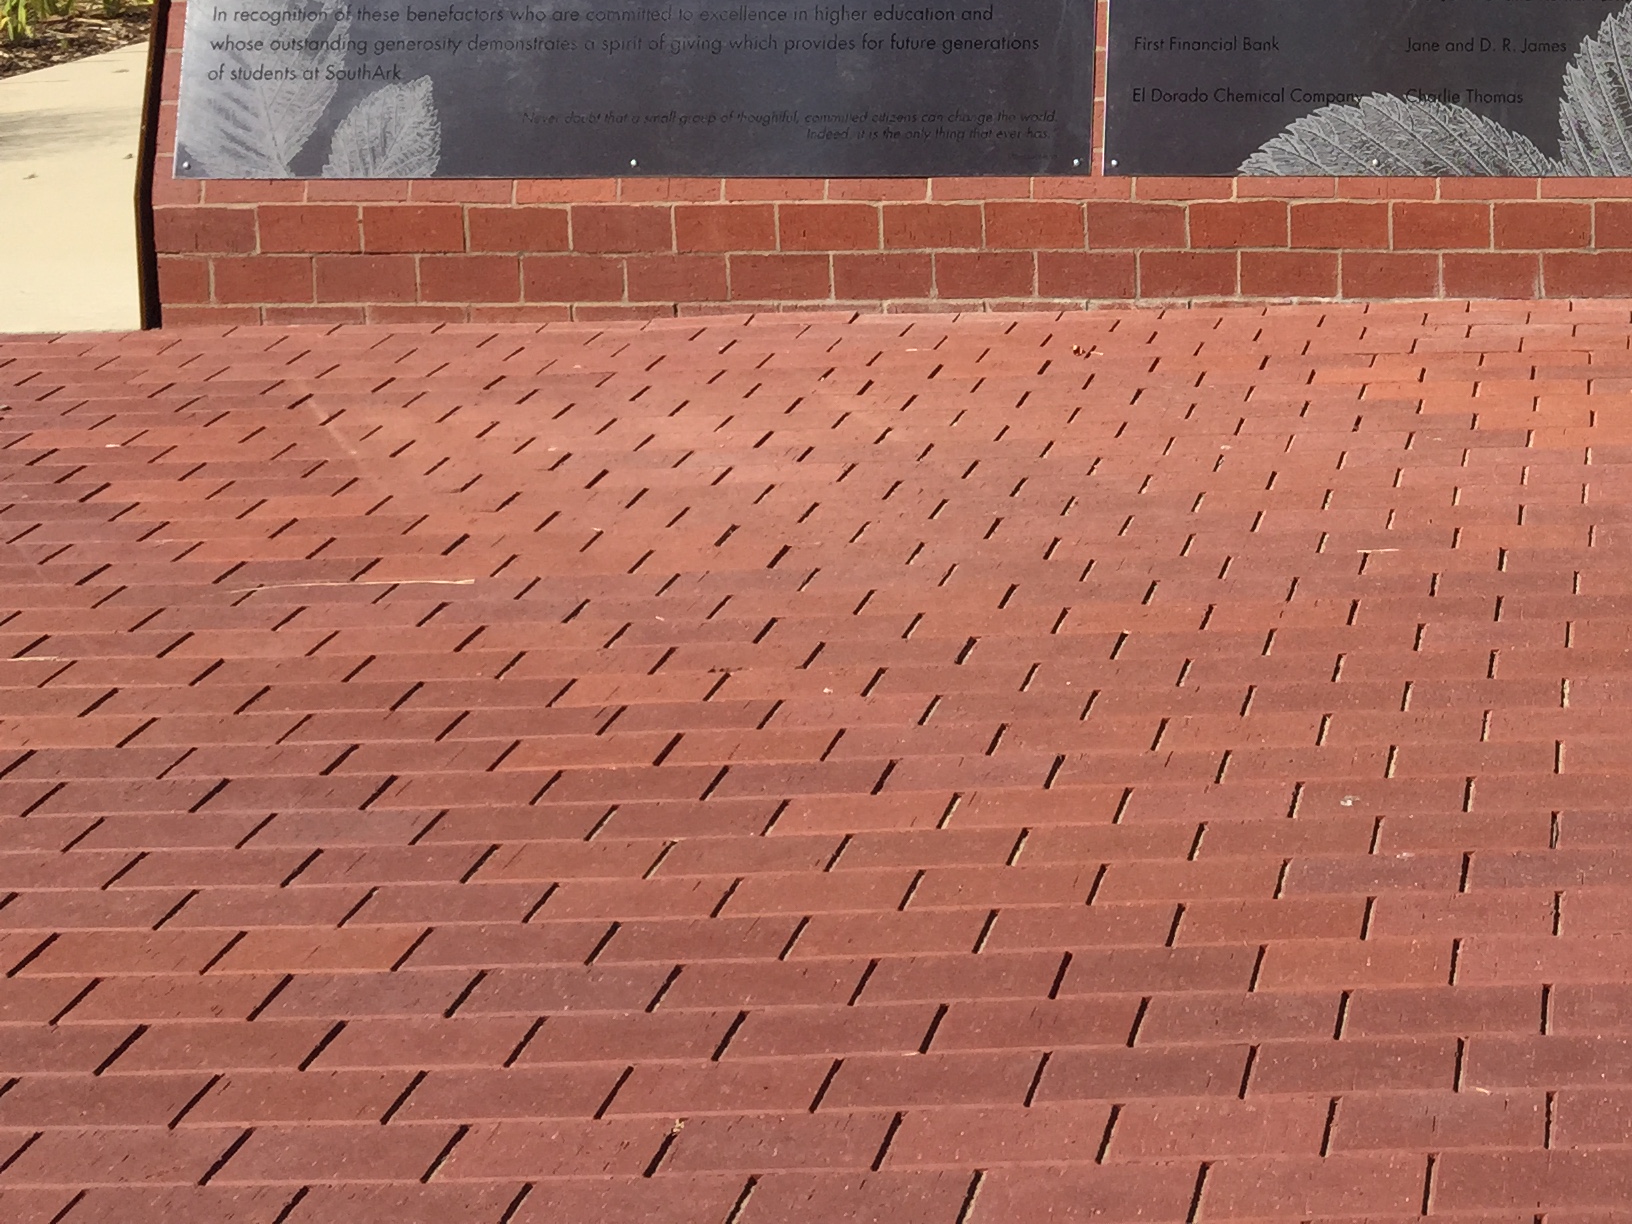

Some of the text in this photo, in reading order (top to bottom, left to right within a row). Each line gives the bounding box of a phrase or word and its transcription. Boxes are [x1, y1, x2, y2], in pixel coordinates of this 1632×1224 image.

[212, 6, 993, 26] In recognition of these benefactors who are committed to excellence in higher education and
[210, 33, 1040, 55] whose outstanding generosity demonstrates a spirit of giving which provides for future generations
[1134, 37, 1279, 51] First Financial Bank
[1405, 38, 1567, 53] Jane and D. R. James
[207, 64, 401, 80] of students at SouthArk
[1133, 88, 1363, 107] El Dorado Chemical Company
[1406, 88, 1524, 104] Charlie Thomas
[564, 111, 601, 123] doubt
[604, 111, 627, 123] that
[631, 115, 640, 123] a
[643, 111, 676, 123] small
[678, 115, 716, 126] group
[721, 111, 735, 123] of
[805, 111, 868, 123] committed
[872, 111, 917, 123] citizens
[921, 114, 943, 122] can
[948, 111, 993, 126] change
[997, 111, 1016, 123] the
[856, 128, 865, 139] it
[868, 128, 879, 139] is
[883, 128, 901, 139] the
[905, 128, 931, 142] only
[935, 128, 965, 142] thing
[969, 128, 993, 139] that
[995, 131, 1022, 139] ever
